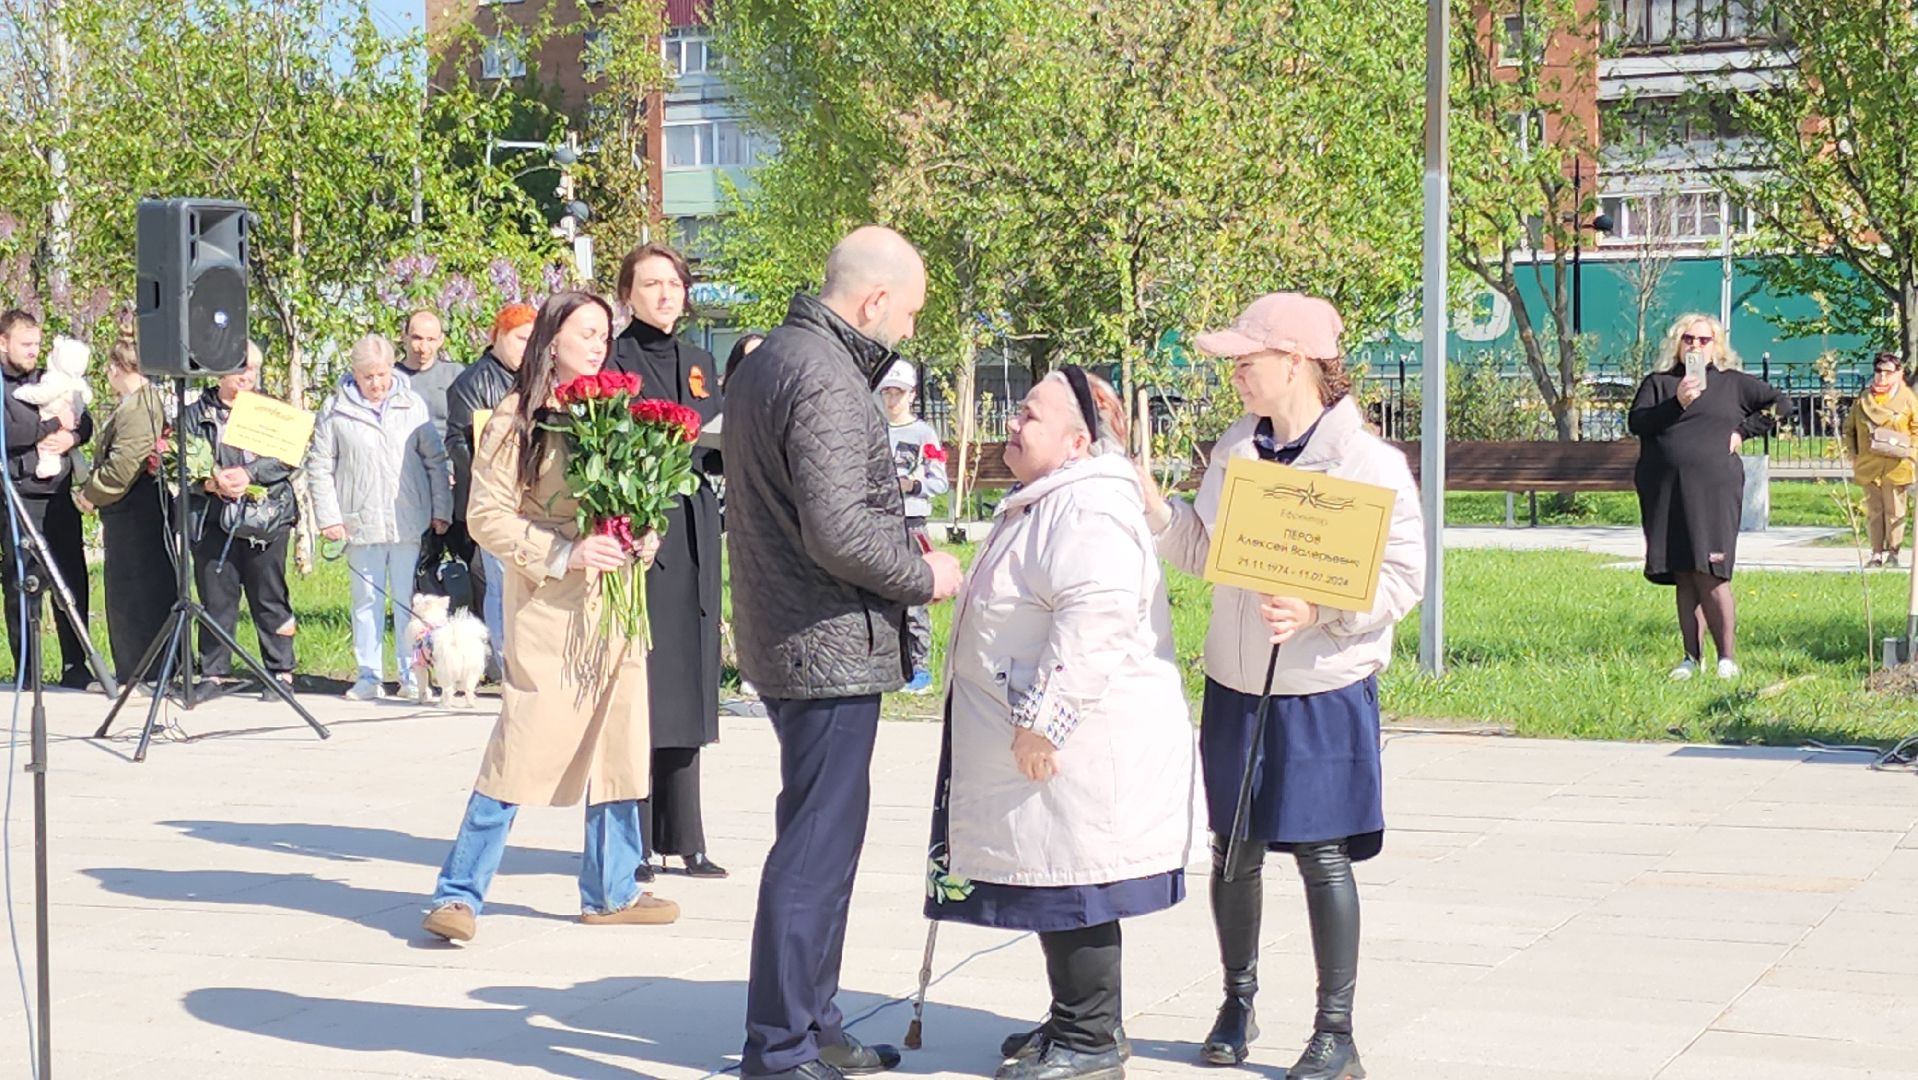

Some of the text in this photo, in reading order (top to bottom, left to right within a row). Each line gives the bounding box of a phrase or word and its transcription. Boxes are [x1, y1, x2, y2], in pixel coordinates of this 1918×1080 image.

[1284, 528, 1320, 544] ПЕРОВ
[1237, 534, 1359, 567] Алексей Валерьевич
